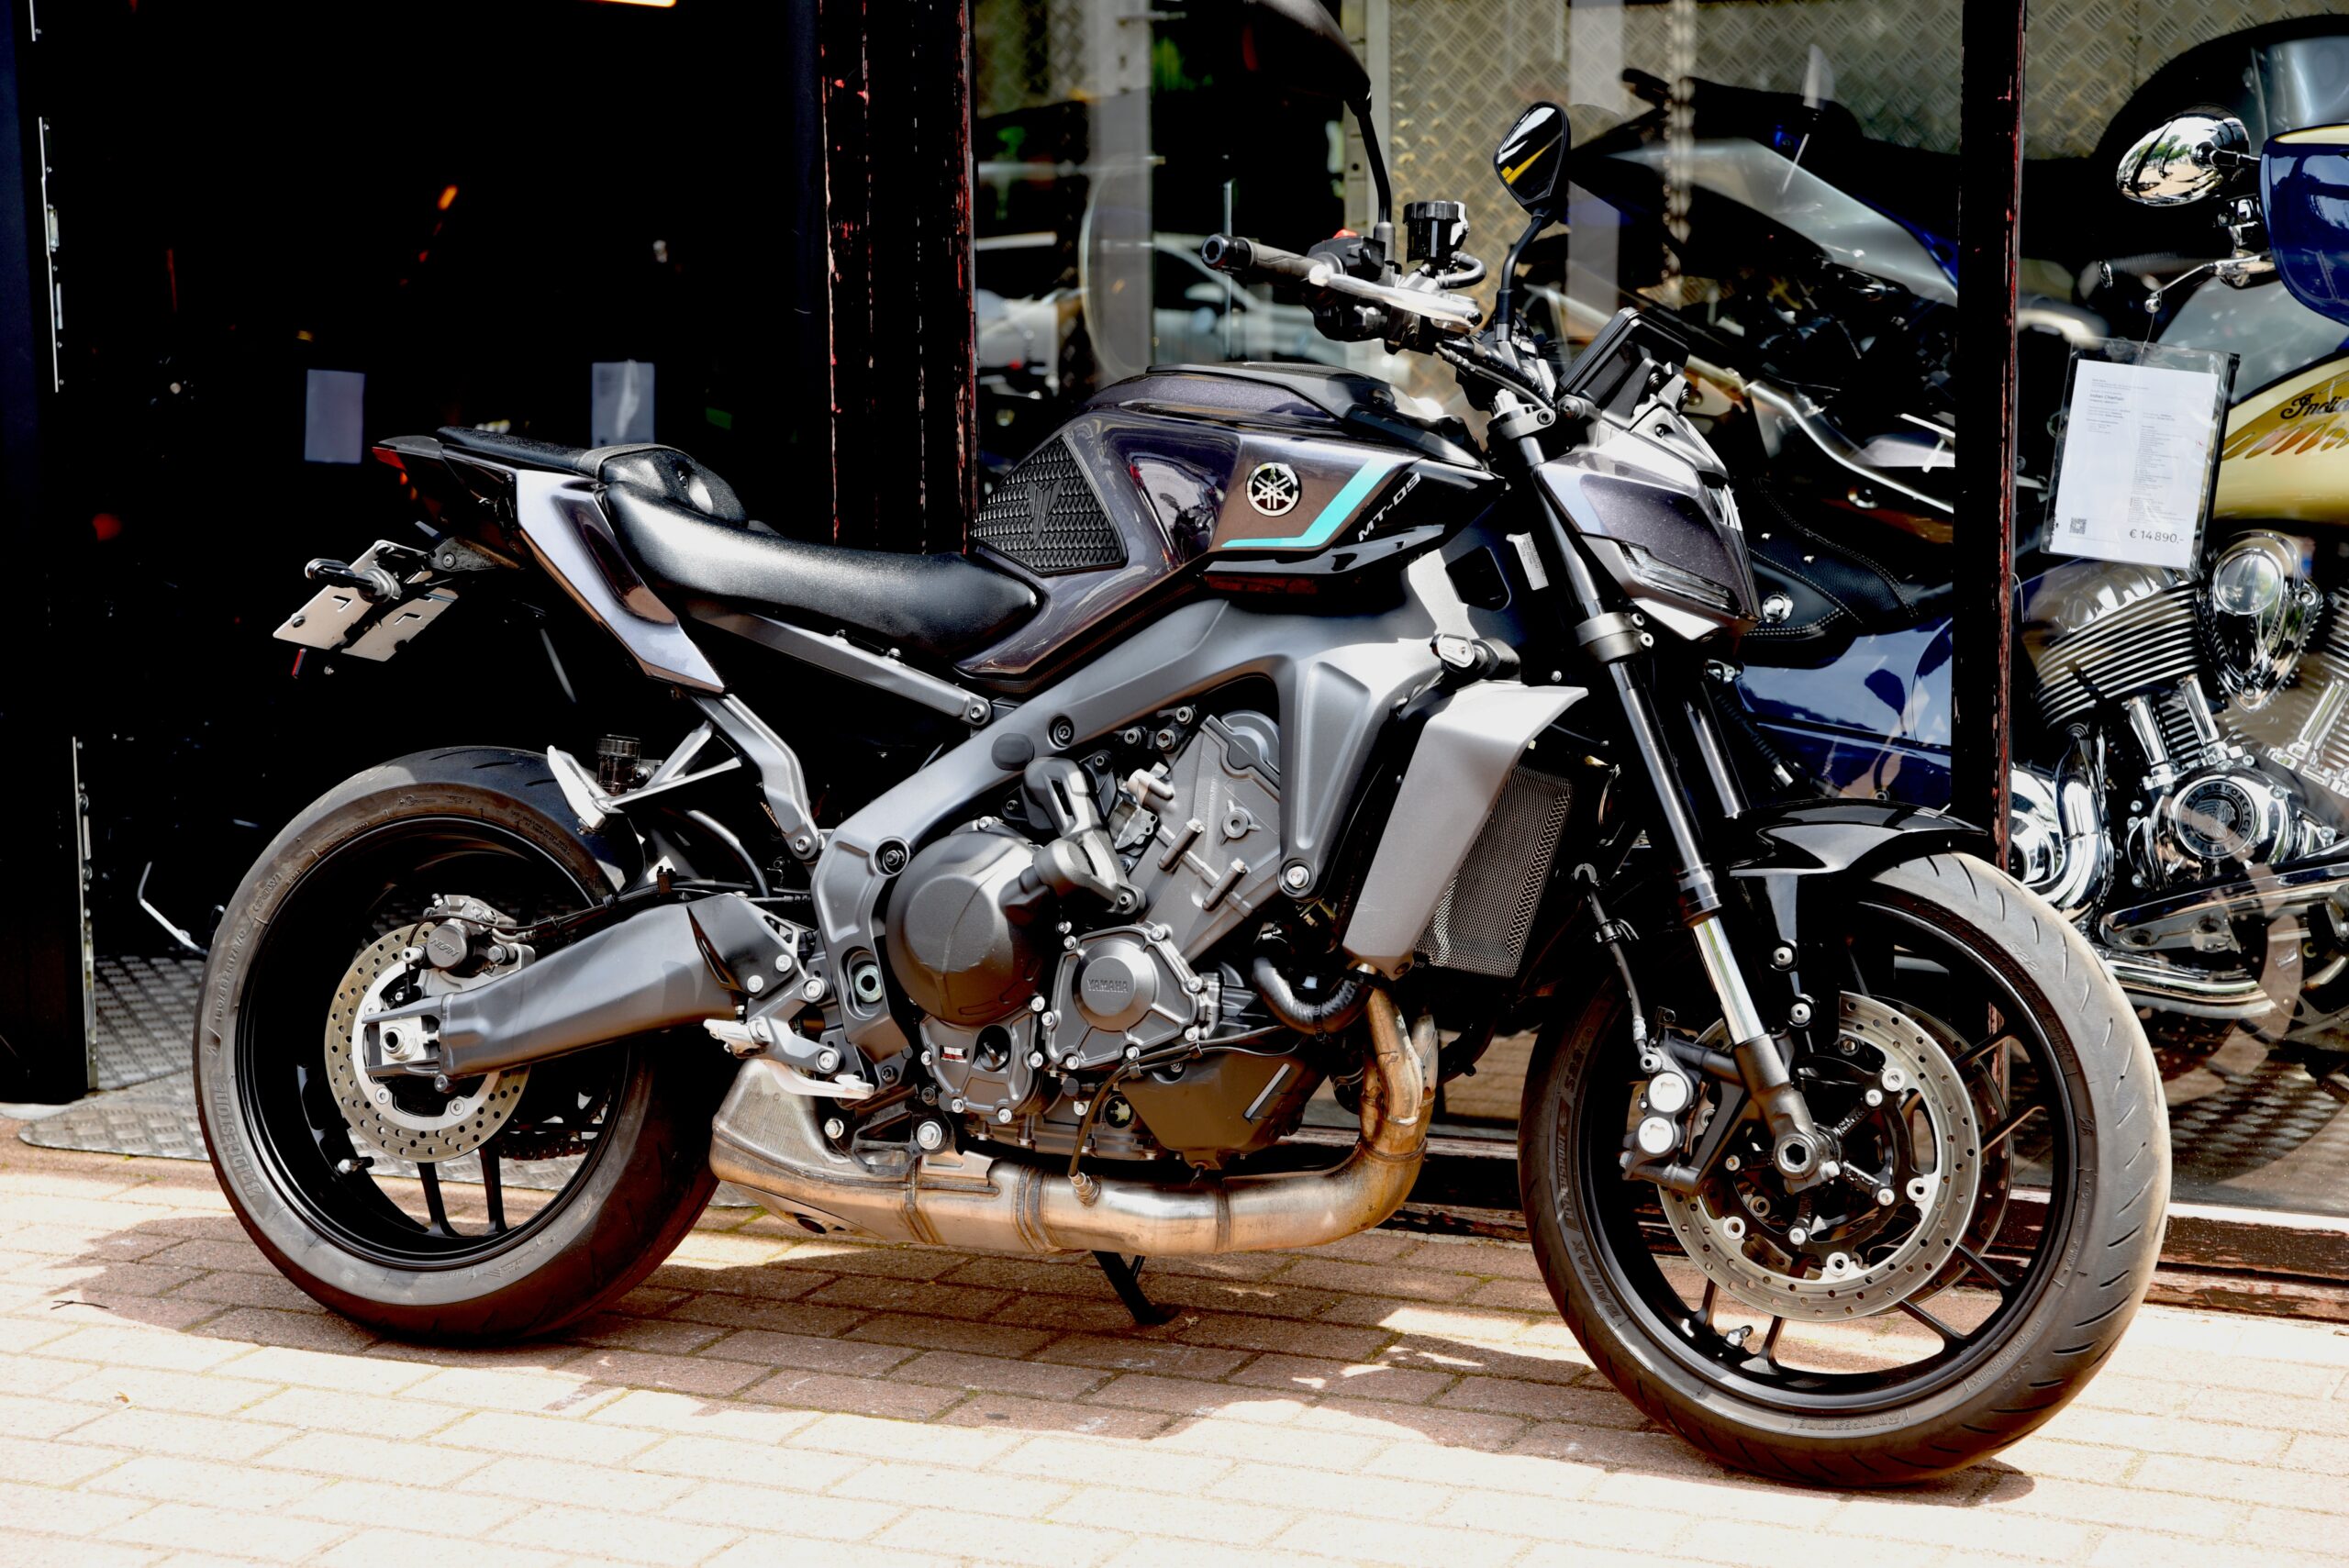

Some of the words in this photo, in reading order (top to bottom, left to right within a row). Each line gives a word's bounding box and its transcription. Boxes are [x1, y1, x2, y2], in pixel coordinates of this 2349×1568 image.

[1358, 472, 1421, 542] MT-09
[2130, 528, 2137, 539] €
[2006, 941, 2039, 973] S22
[1087, 978, 1129, 994] YAMAHA
[213, 1082, 264, 1198] BRIDGESTONE
[1572, 1240, 1622, 1320] BATTLAX
